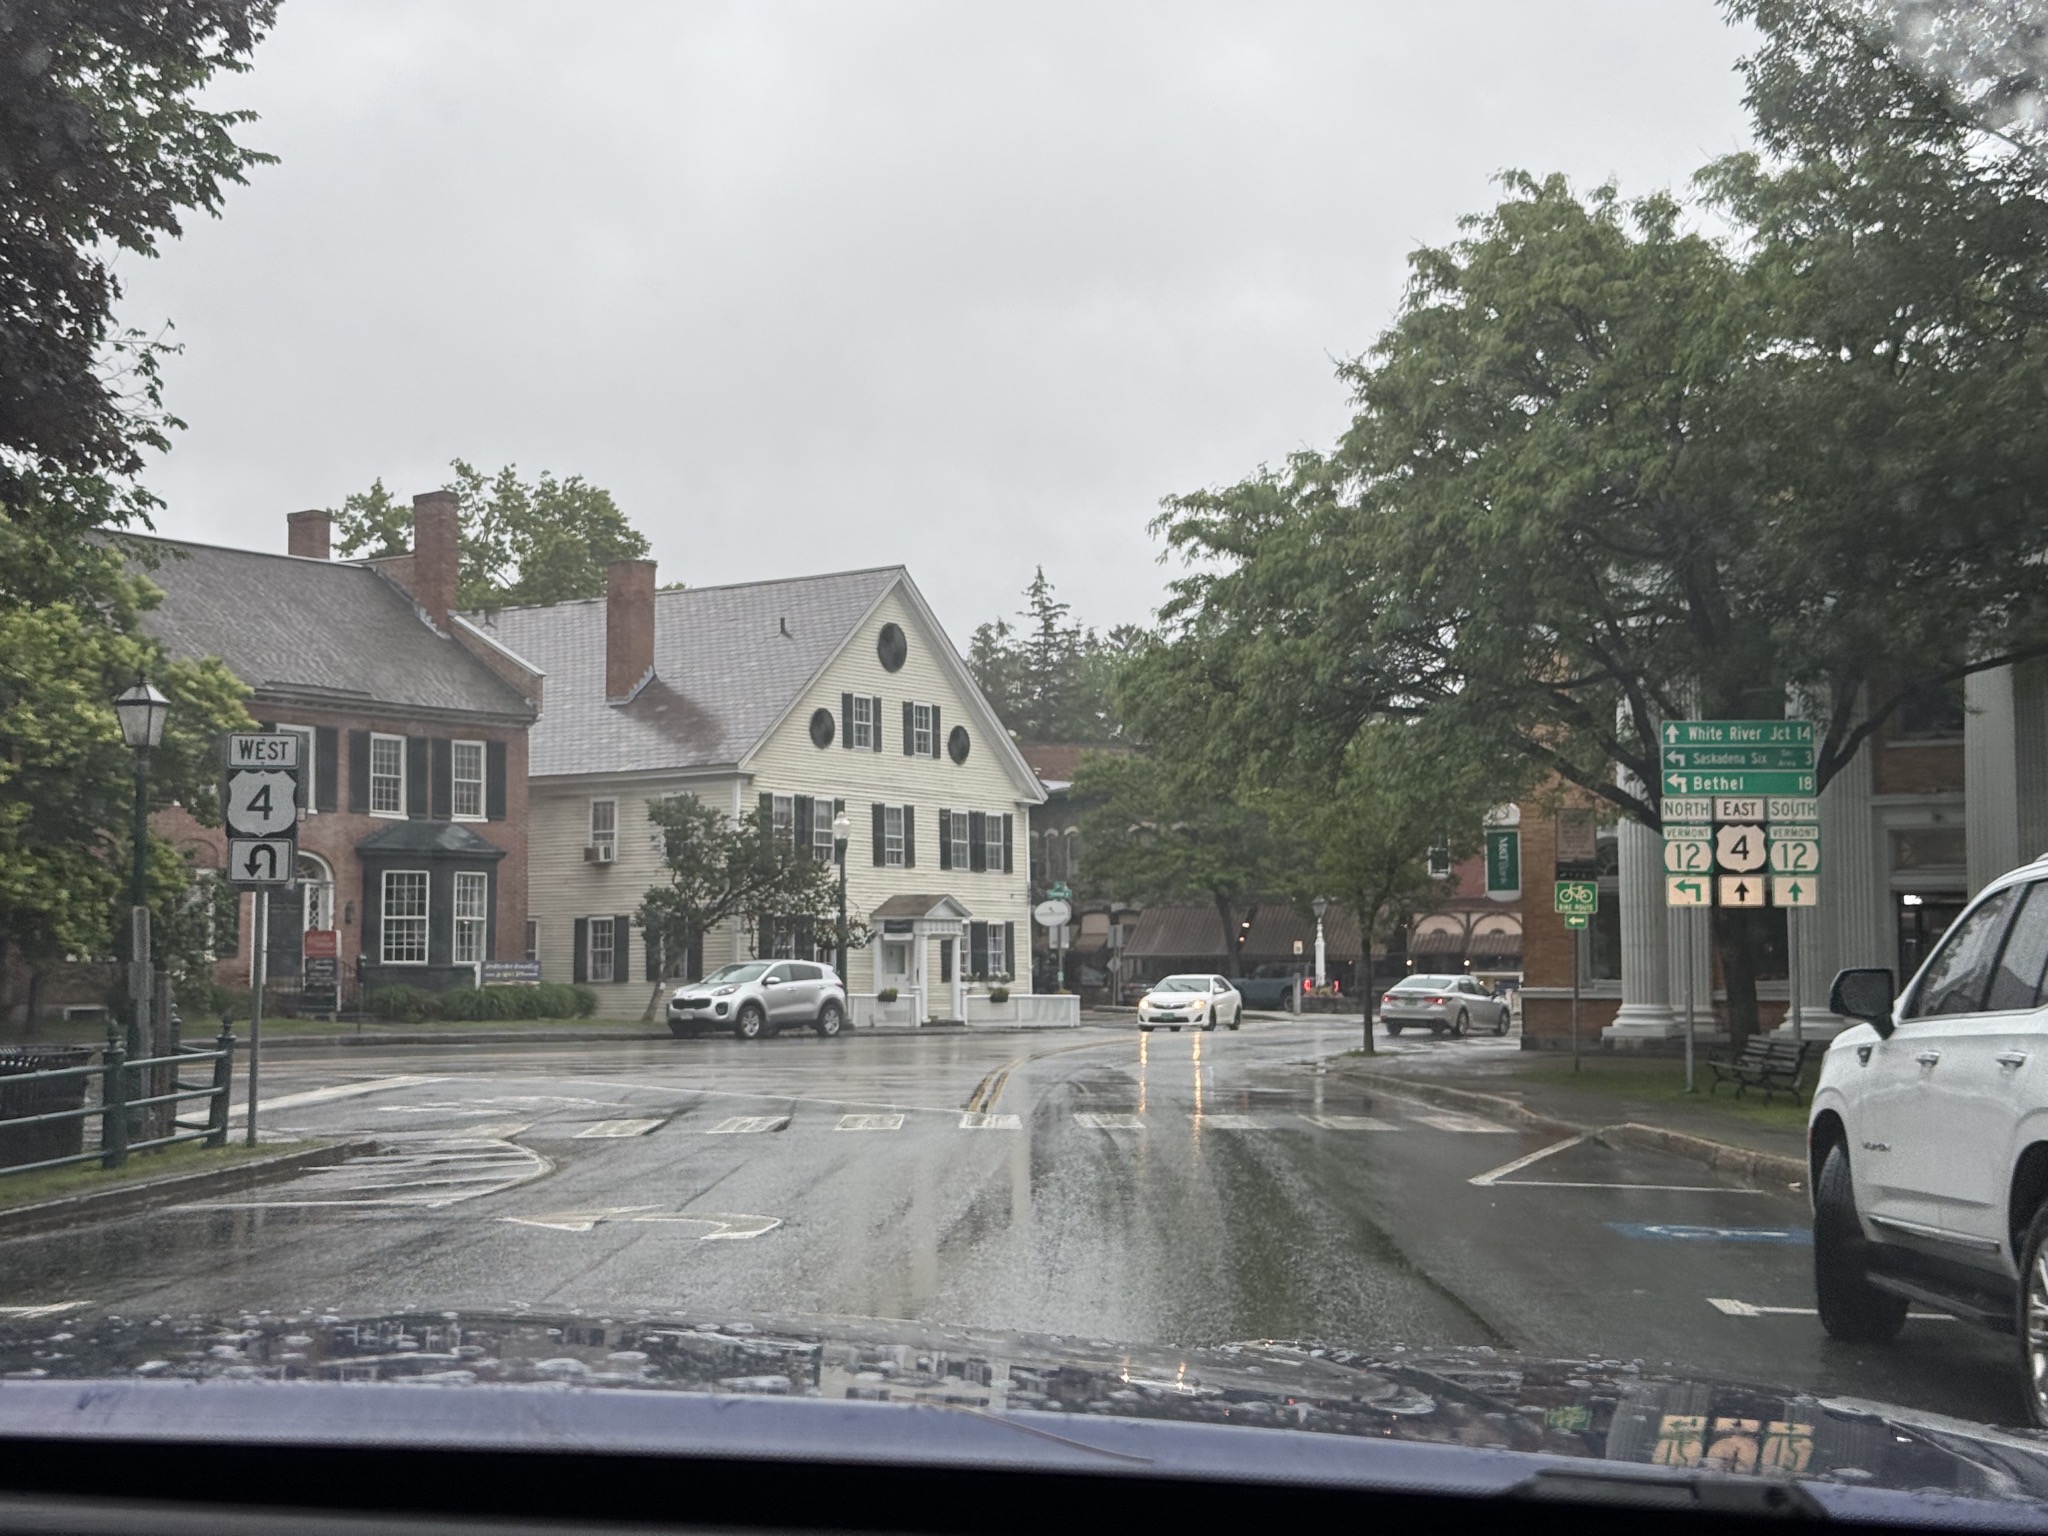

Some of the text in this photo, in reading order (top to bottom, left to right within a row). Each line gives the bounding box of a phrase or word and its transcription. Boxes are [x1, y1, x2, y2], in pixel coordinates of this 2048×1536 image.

[1689, 727, 1812, 741] White River Jct 14
[239, 739, 288, 760] WEST
[1805, 751, 1813, 766] 3
[1693, 776, 1813, 791] Bethel 18
[246, 784, 273, 821] 4
[1664, 801, 1709, 816] NORTH
[1723, 801, 1757, 816] EAST
[1771, 801, 1817, 816] SOUTH
[1667, 829, 1709, 838] VERMONT
[1773, 829, 1816, 838] VERMONT
[1730, 834, 1750, 861] 4
[1675, 843, 1701, 869] 12
[1781, 843, 1808, 869] 12
